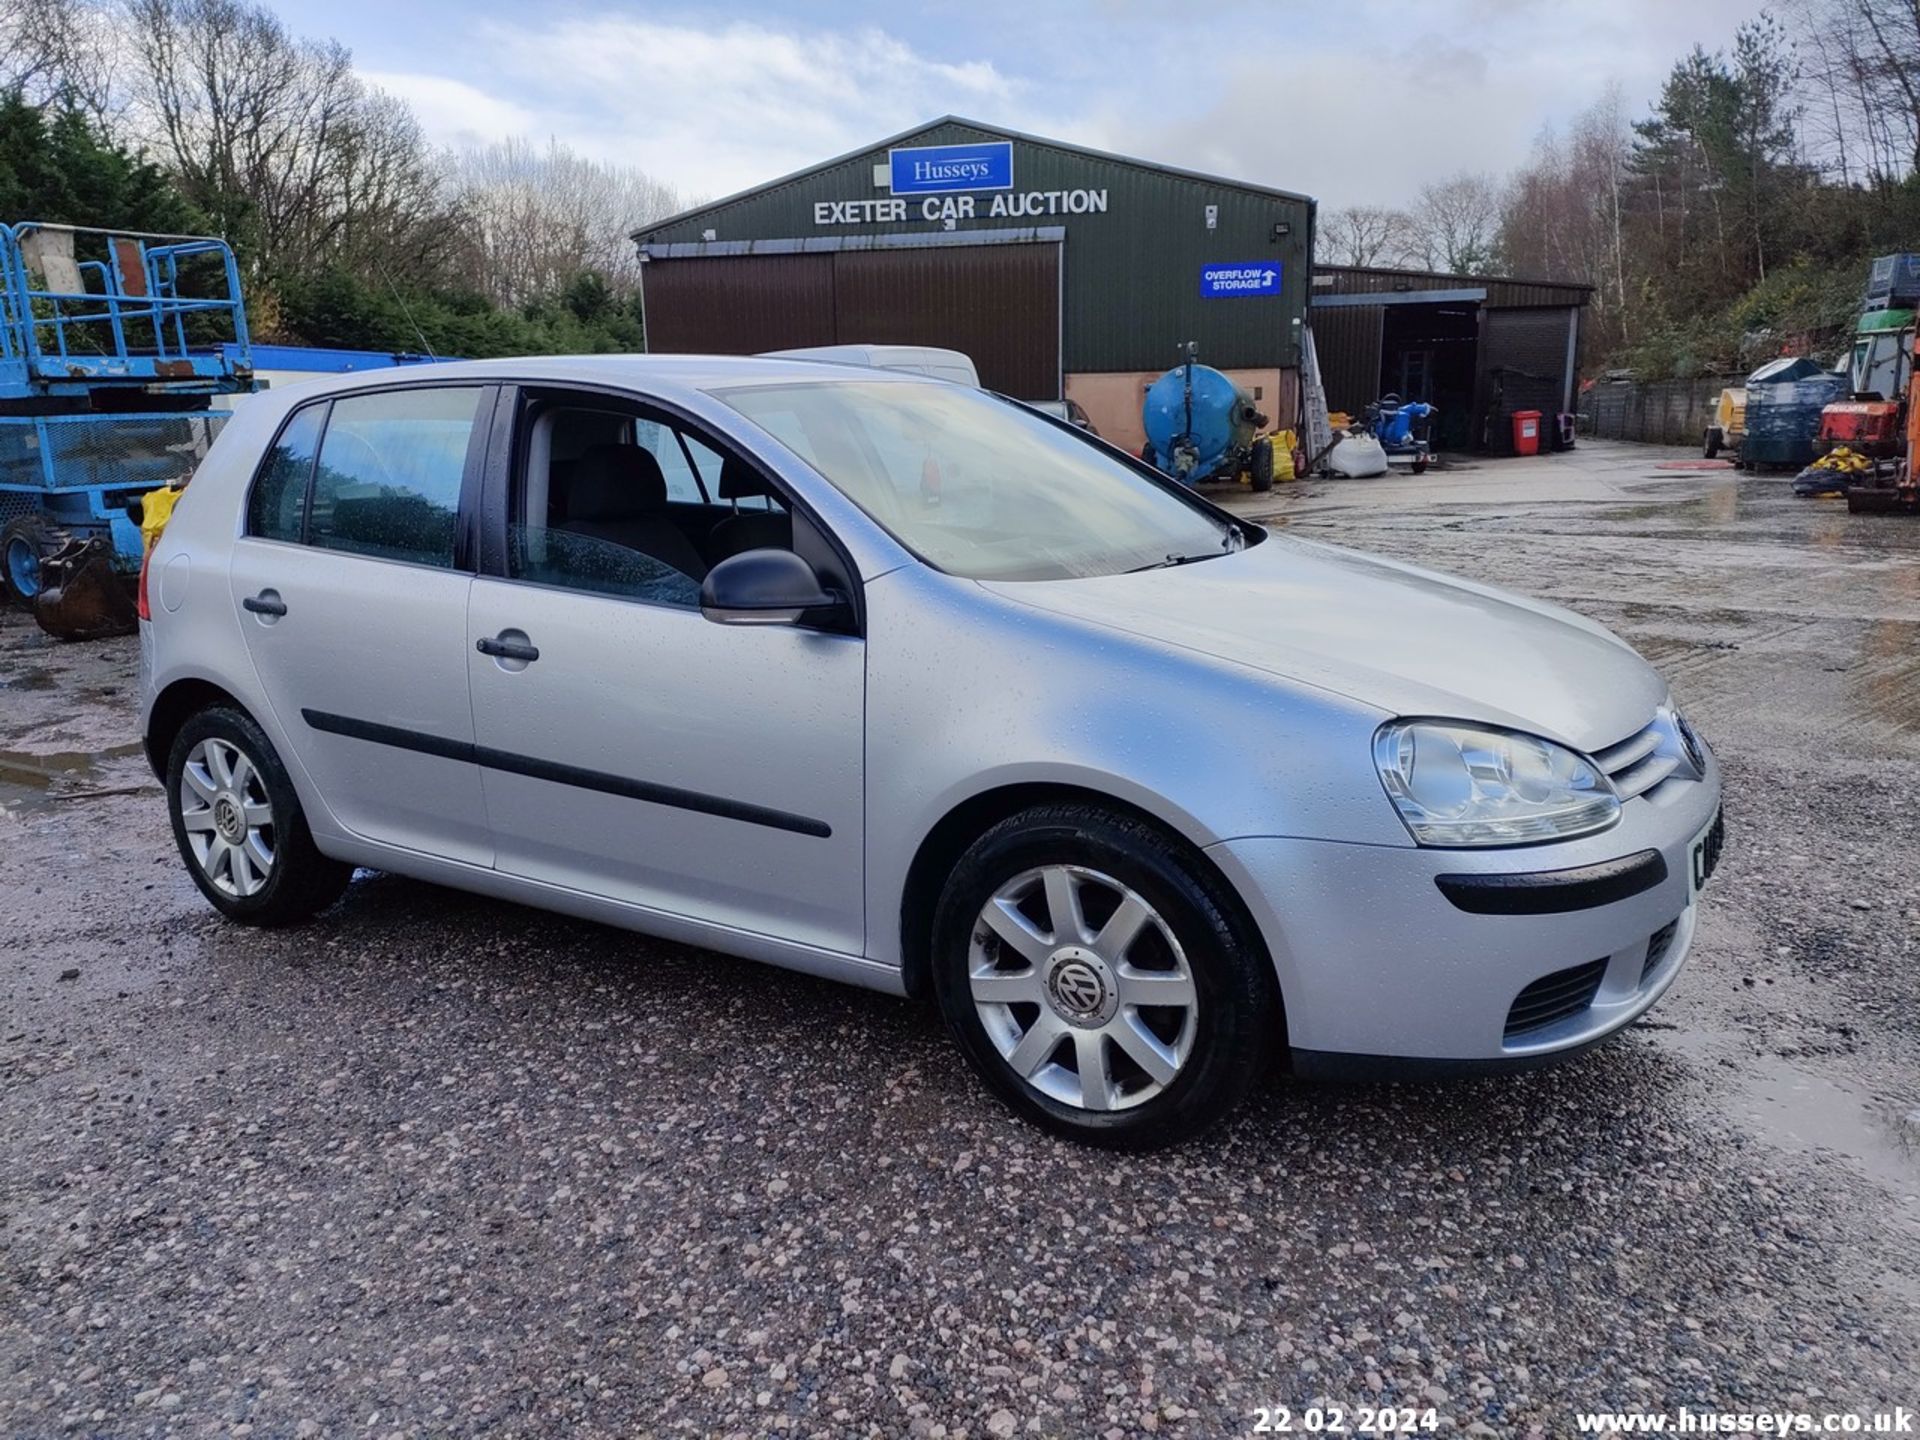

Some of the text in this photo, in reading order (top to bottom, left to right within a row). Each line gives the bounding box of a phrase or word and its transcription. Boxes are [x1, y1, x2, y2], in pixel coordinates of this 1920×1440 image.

[914, 161, 989, 181] Husseys
[814, 189, 1108, 225] EXETER CAR AUCTION
[1205, 269, 1262, 281] OVERFLOW
[1212, 279, 1261, 291] STORAGE
